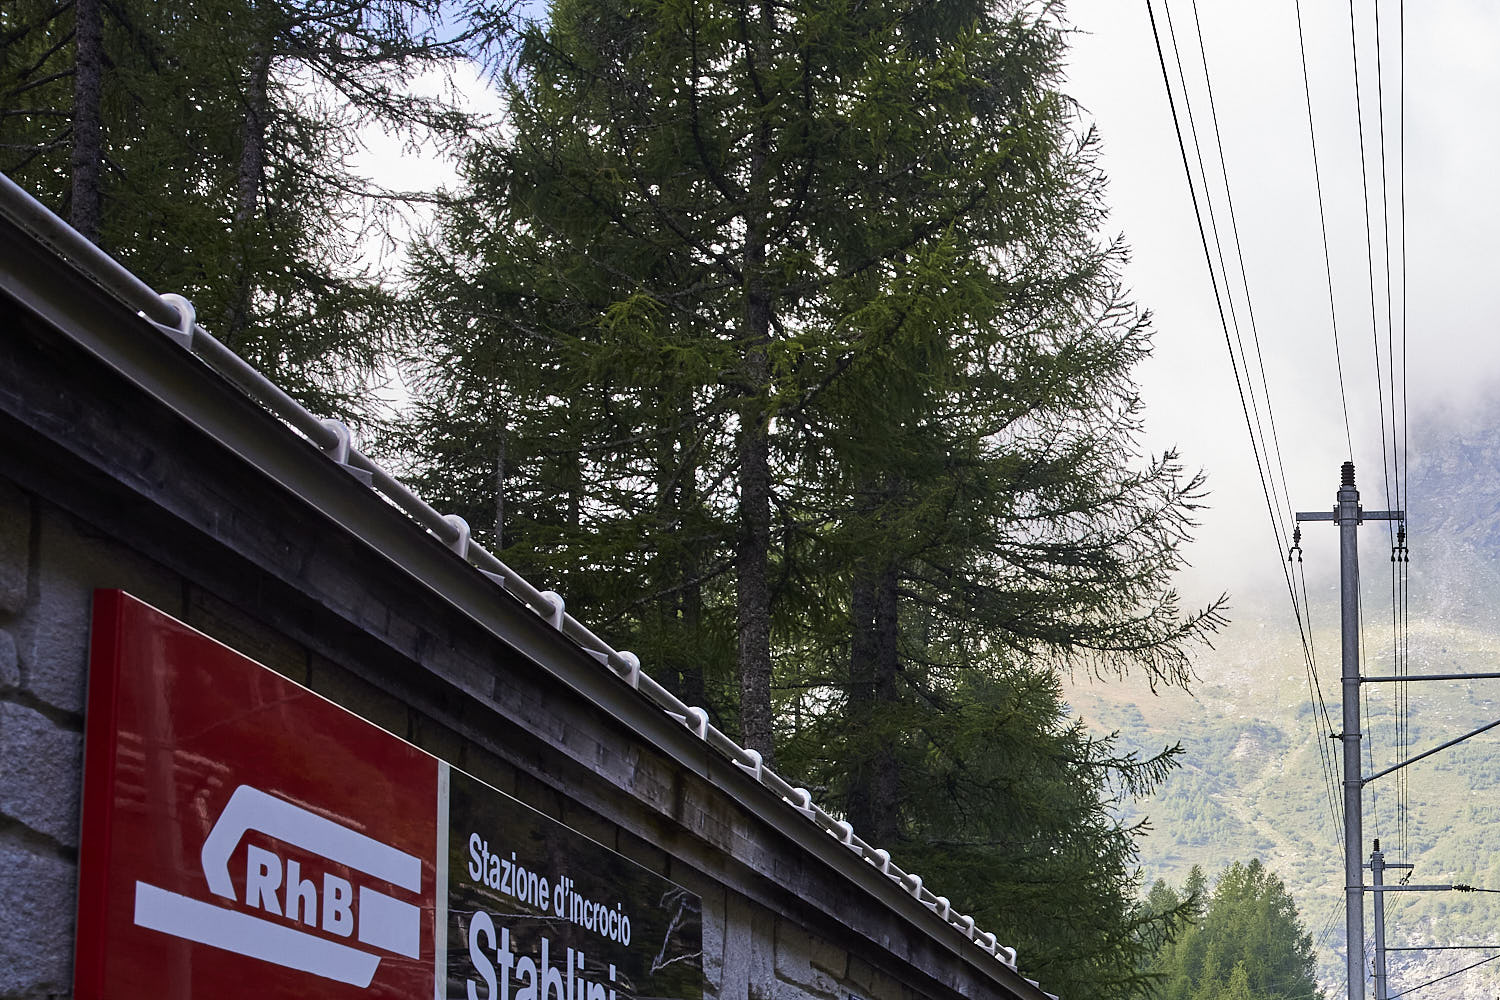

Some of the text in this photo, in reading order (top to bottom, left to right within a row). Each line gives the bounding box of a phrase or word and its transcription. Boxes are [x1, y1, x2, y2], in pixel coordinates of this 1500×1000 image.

[245, 843, 355, 938] RhB
[468, 832, 632, 947] Stazione d'incrocio
